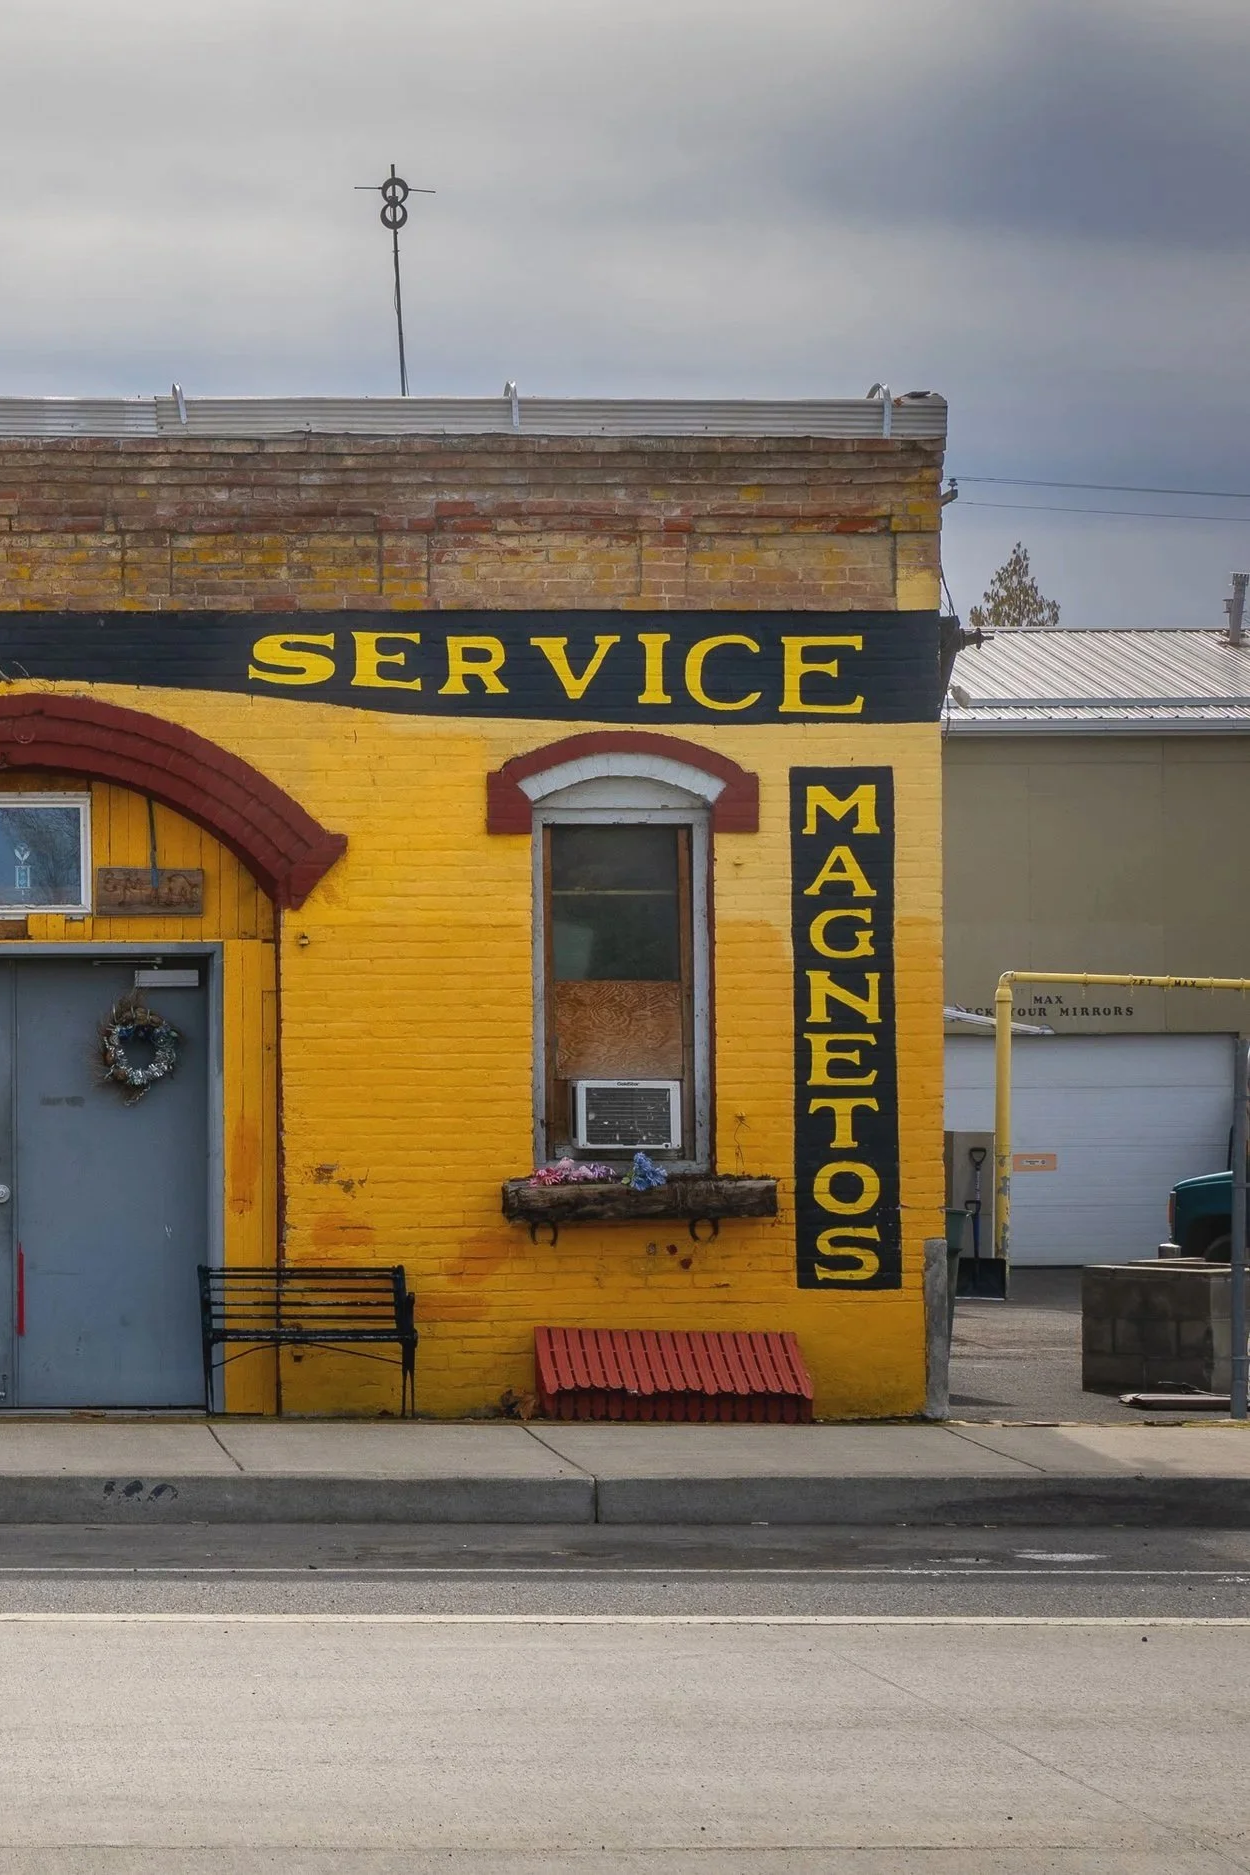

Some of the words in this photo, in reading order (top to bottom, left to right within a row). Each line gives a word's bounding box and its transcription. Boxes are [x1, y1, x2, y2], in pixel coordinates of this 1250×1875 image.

[249, 632, 864, 713] SERVICE
[1174, 980, 1196, 988] MAX
[1033, 995, 1063, 1005] MAX
[1059, 1006, 1134, 1017] MIRRORS
[802, 785, 881, 1281] MAGNETOS
